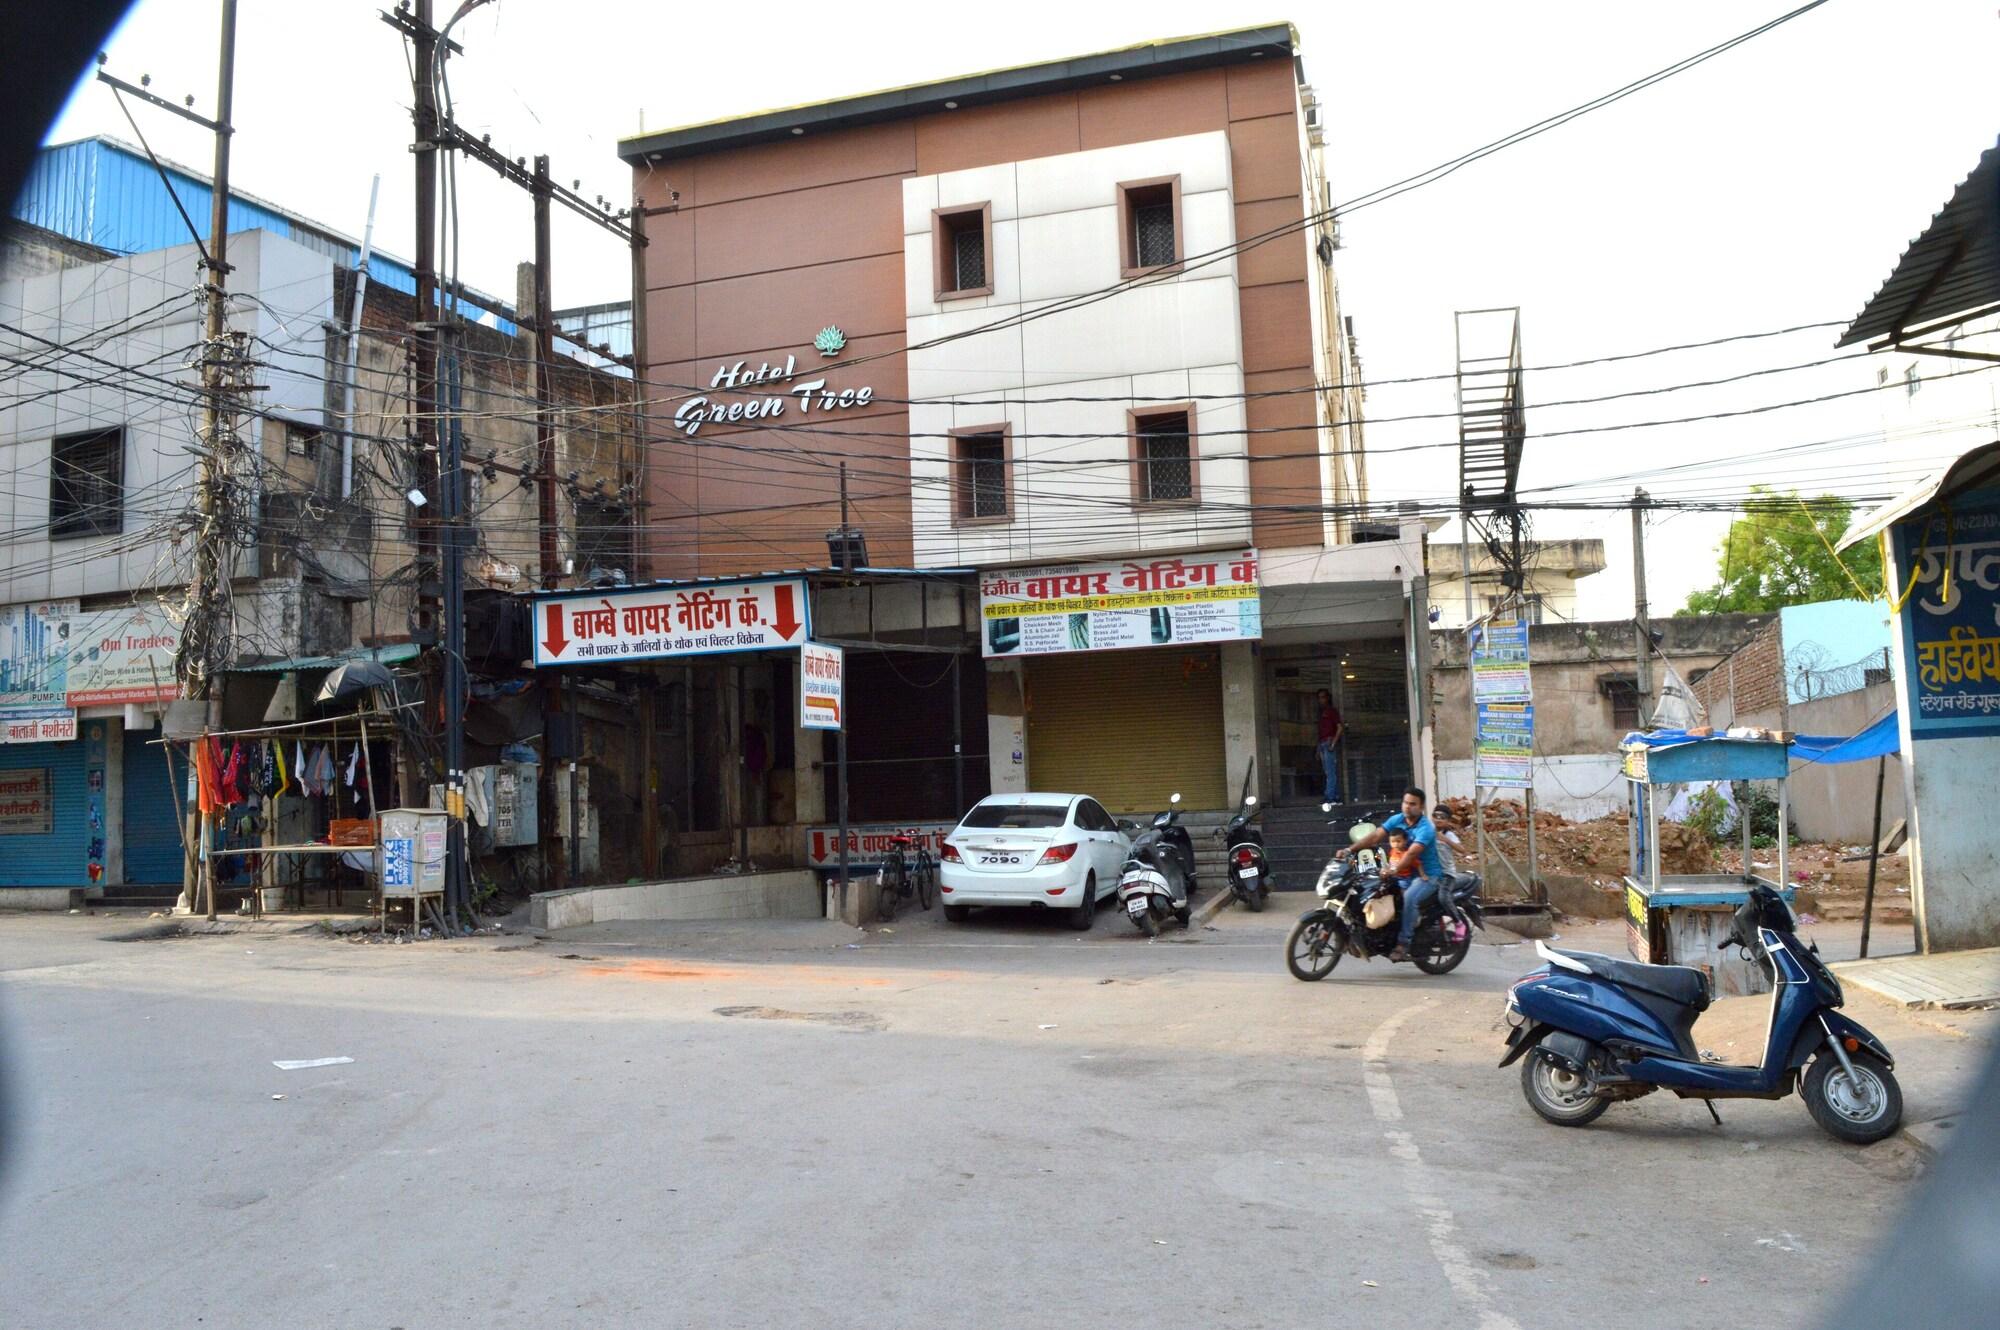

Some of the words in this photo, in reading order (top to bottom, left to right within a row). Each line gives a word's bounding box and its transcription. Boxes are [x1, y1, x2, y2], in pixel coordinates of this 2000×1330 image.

[710, 354, 796, 388] Hotel
[674, 396, 785, 435] Green
[791, 378, 873, 413] Tree
[981, 579, 1020, 596] रंजीत
[1024, 572, 1111, 599] वायर
[1120, 559, 1218, 591] नेटिंग
[572, 599, 617, 640] बाम्बे
[622, 604, 671, 636] वायर
[676, 589, 731, 631] नेटिंग
[737, 587, 767, 627] कं.
[101, 637, 121, 652] Om
[126, 634, 175, 650] Traders
[577, 643, 594, 657] सभी
[596, 644, 618, 656] प्रकार
[621, 641, 629, 653] के
[632, 638, 661, 653] जालियों
[663, 637, 672, 651] के
[674, 636, 693, 650] थोक
[695, 635, 708, 648] एवं
[737, 631, 764, 645] विक्रेता
[32, 693, 54, 701] PUMP
[8, 720, 38, 739] बालाजी
[981, 856, 1020, 864] 7090
